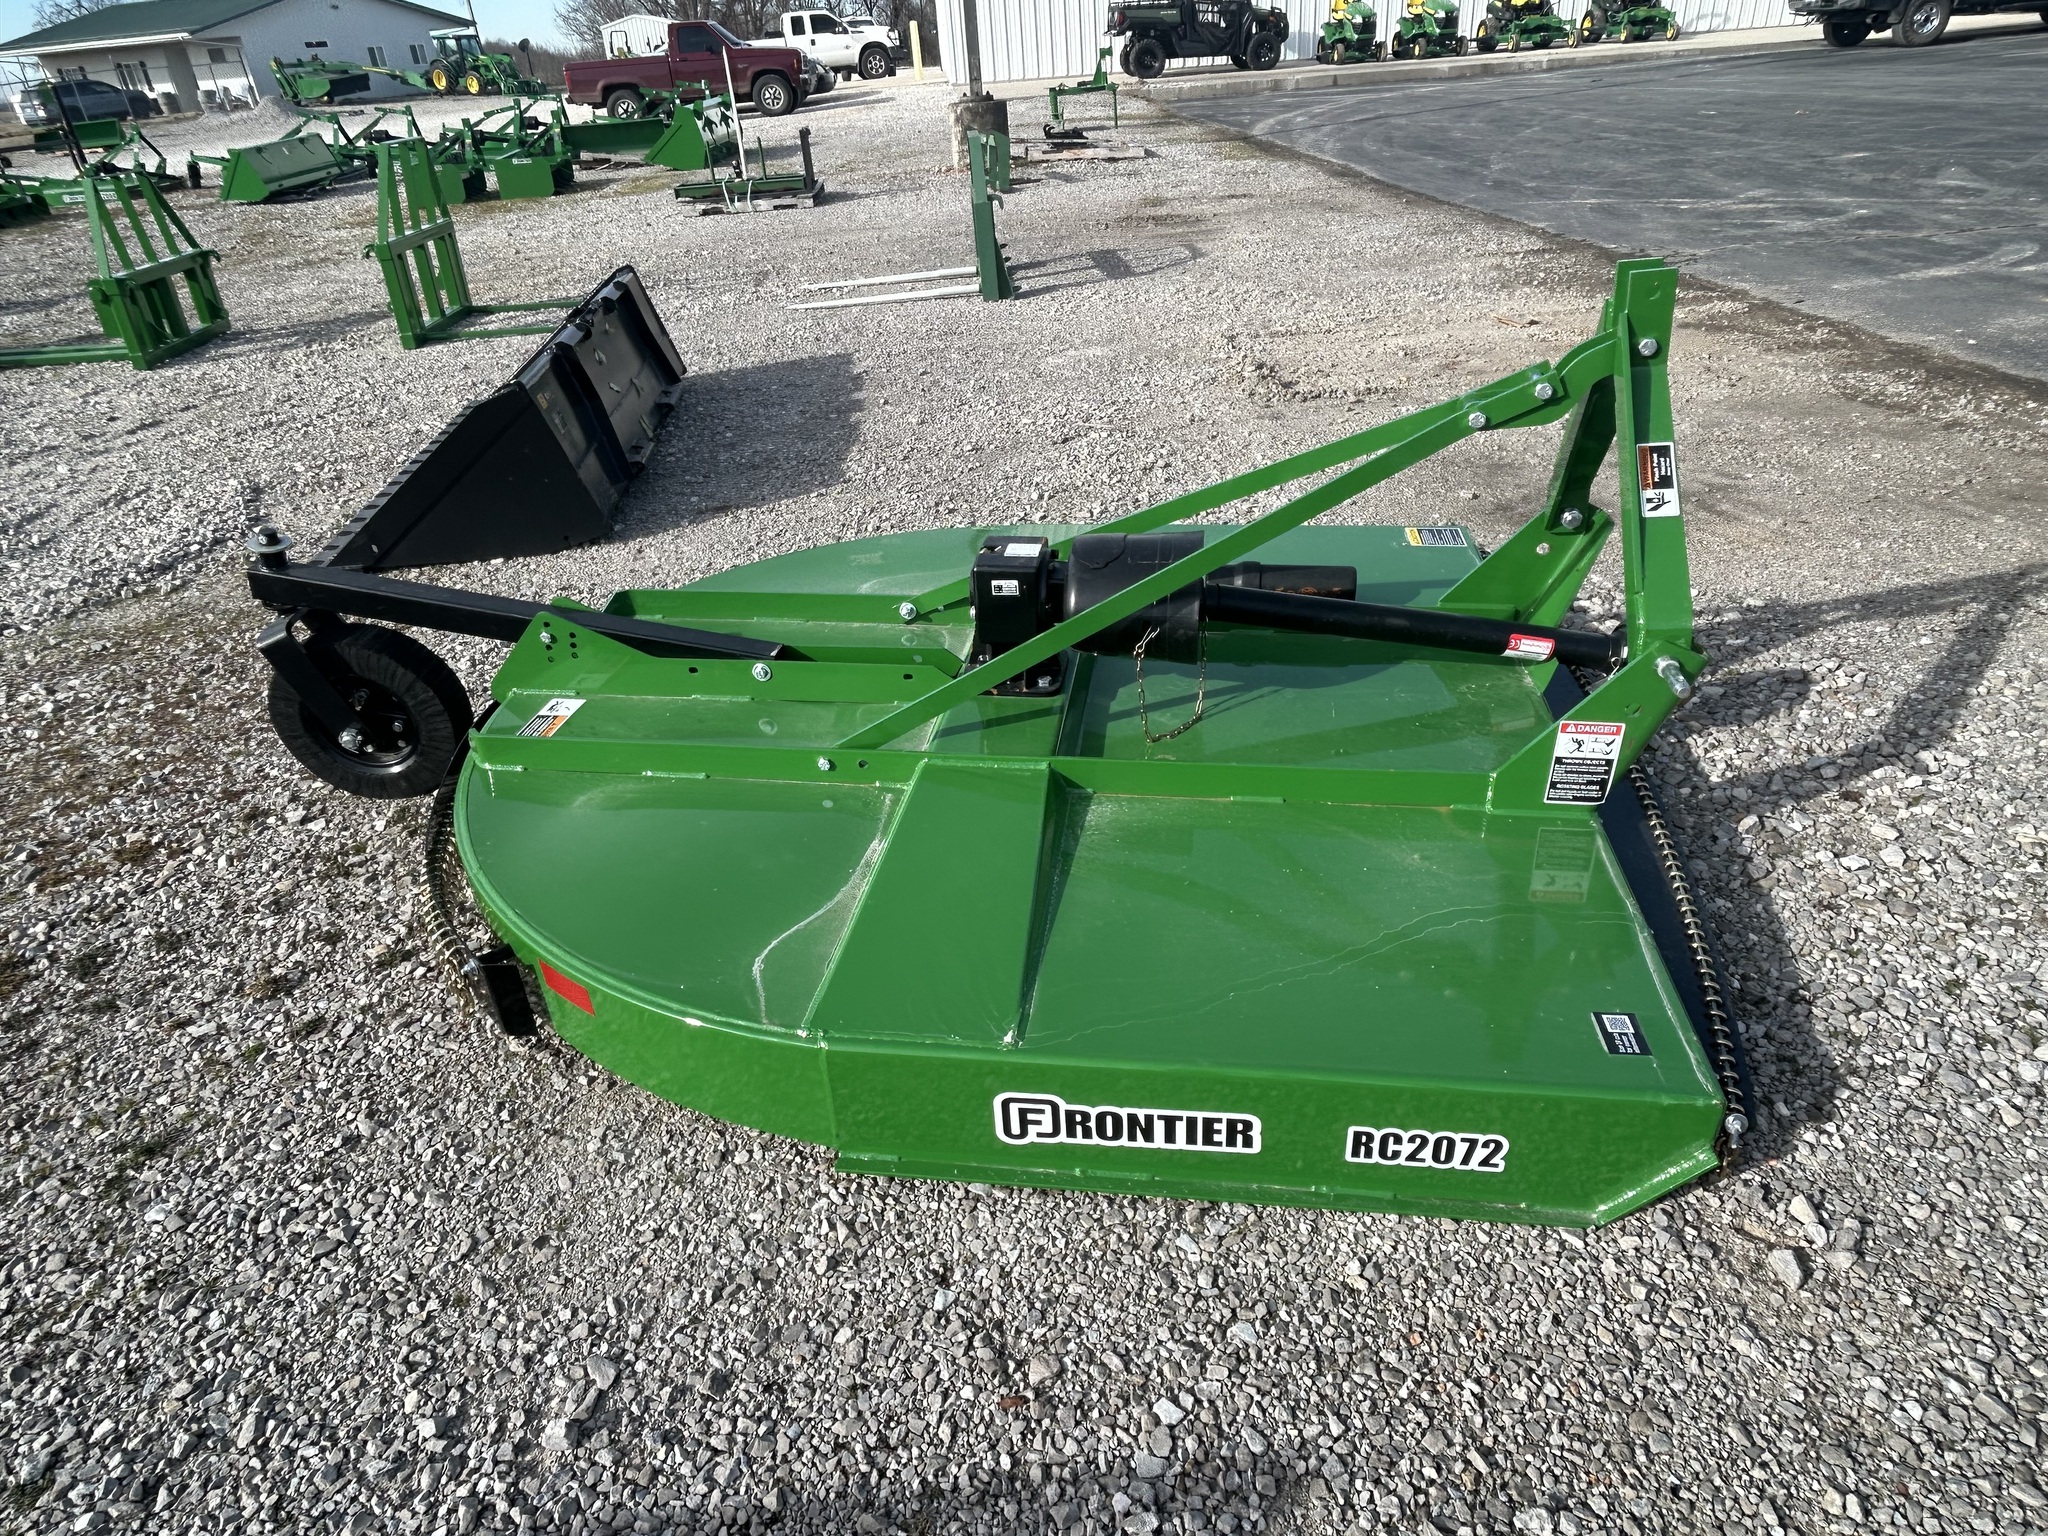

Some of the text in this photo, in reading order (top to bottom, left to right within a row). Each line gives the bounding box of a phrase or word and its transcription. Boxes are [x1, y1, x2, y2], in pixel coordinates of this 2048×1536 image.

[1577, 725, 1617, 734] DANGER
[1000, 1096, 1256, 1151] FRONTIER
[1350, 1130, 1506, 1169] RC2072
